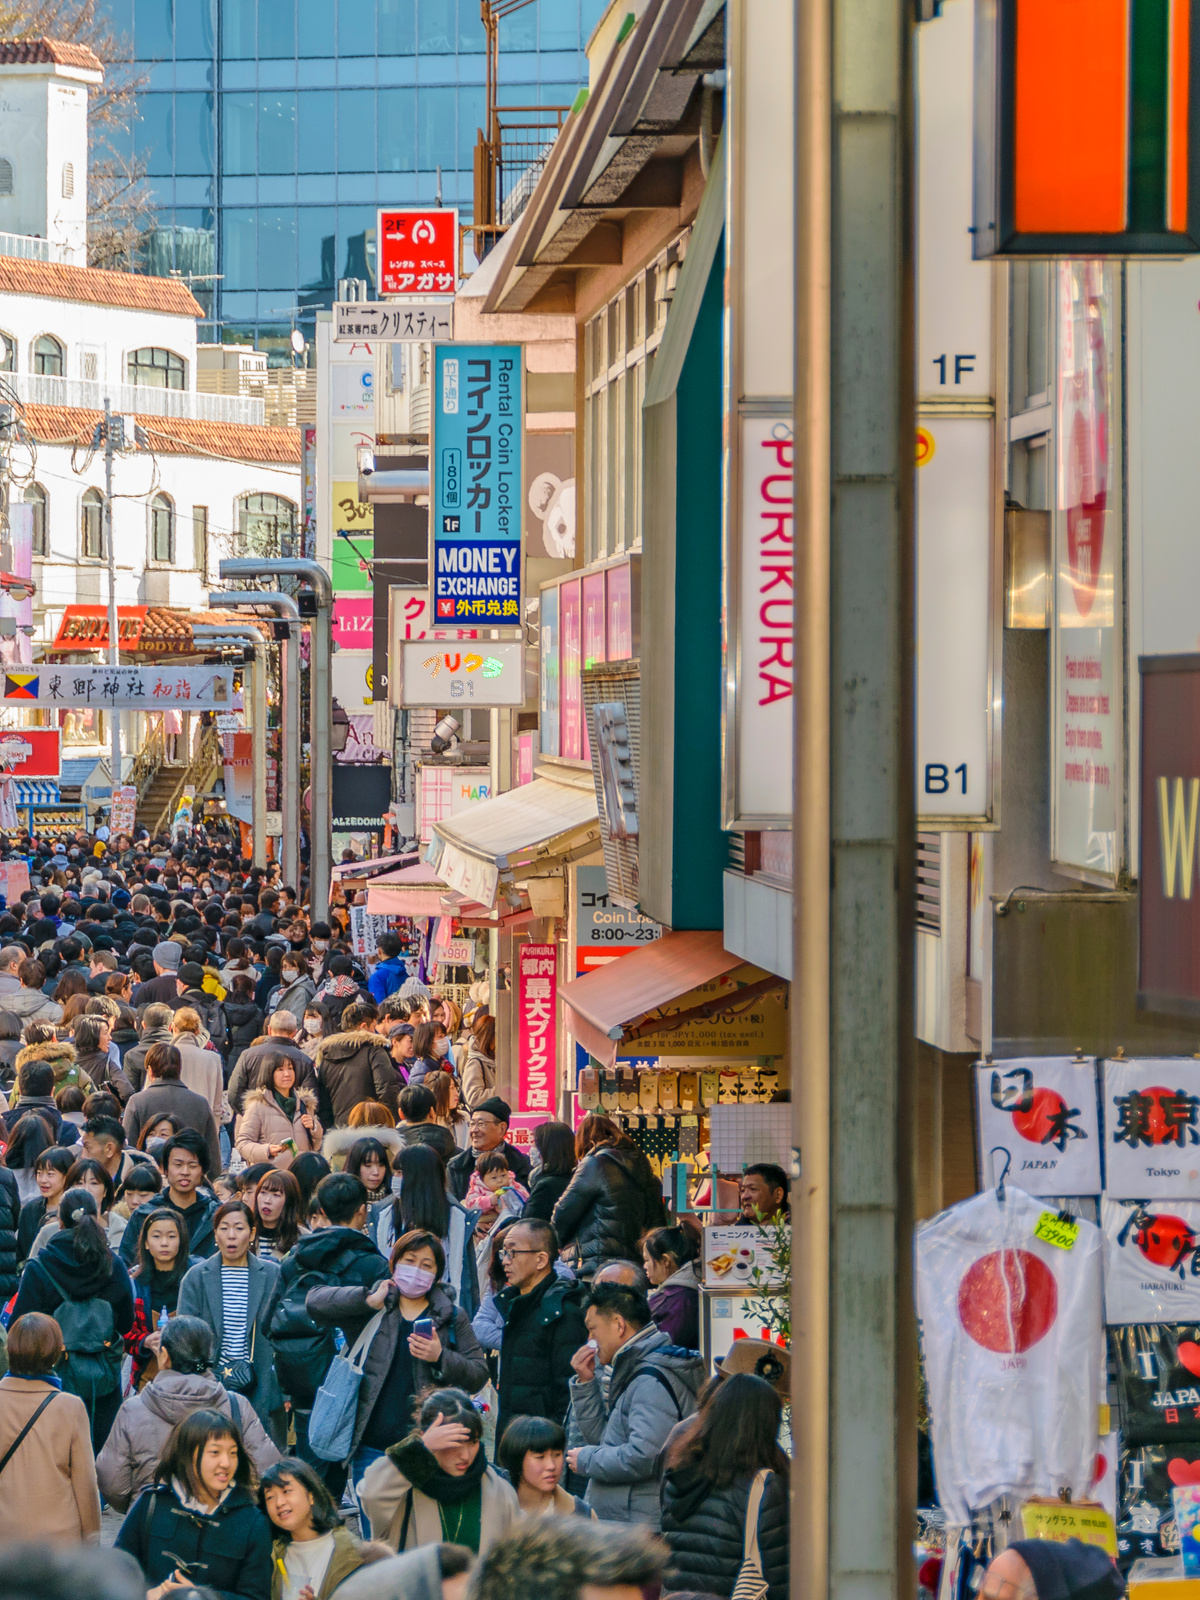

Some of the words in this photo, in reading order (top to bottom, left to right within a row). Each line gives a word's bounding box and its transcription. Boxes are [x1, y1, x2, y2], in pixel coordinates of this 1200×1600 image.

[385, 219, 406, 231] 2F
[397, 272, 454, 291] アガサ
[379, 311, 450, 337] クリスティー
[932, 354, 977, 386] 1F
[498, 358, 514, 418] Rental
[466, 358, 493, 534] コインロッカー
[498, 422, 514, 465] Coin
[498, 471, 514, 535] Locker
[444, 518, 460, 532] 1F
[438, 547, 517, 574] MONEY
[437, 576, 518, 596] EXCHANGE
[456, 599, 519, 617] 外币兑换
[46, 673, 146, 707] 東郷神社
[450, 679, 475, 698] B1
[924, 763, 969, 795] B1
[332, 816, 386, 827] ALZEDONIA
[593, 911, 625, 924] Coin
[522, 958, 555, 976] 都内
[525, 977, 551, 1109] 最大プリクラ店
[990, 1067, 1089, 1153] 日本
[1113, 1088, 1200, 1150] 東京
[1020, 1159, 1059, 1171] JAPAN
[1145, 1167, 1181, 1178] Tokyo
[1140, 1282, 1186, 1291] HARAJUKU
[1152, 1390, 1200, 1407] JAPA
